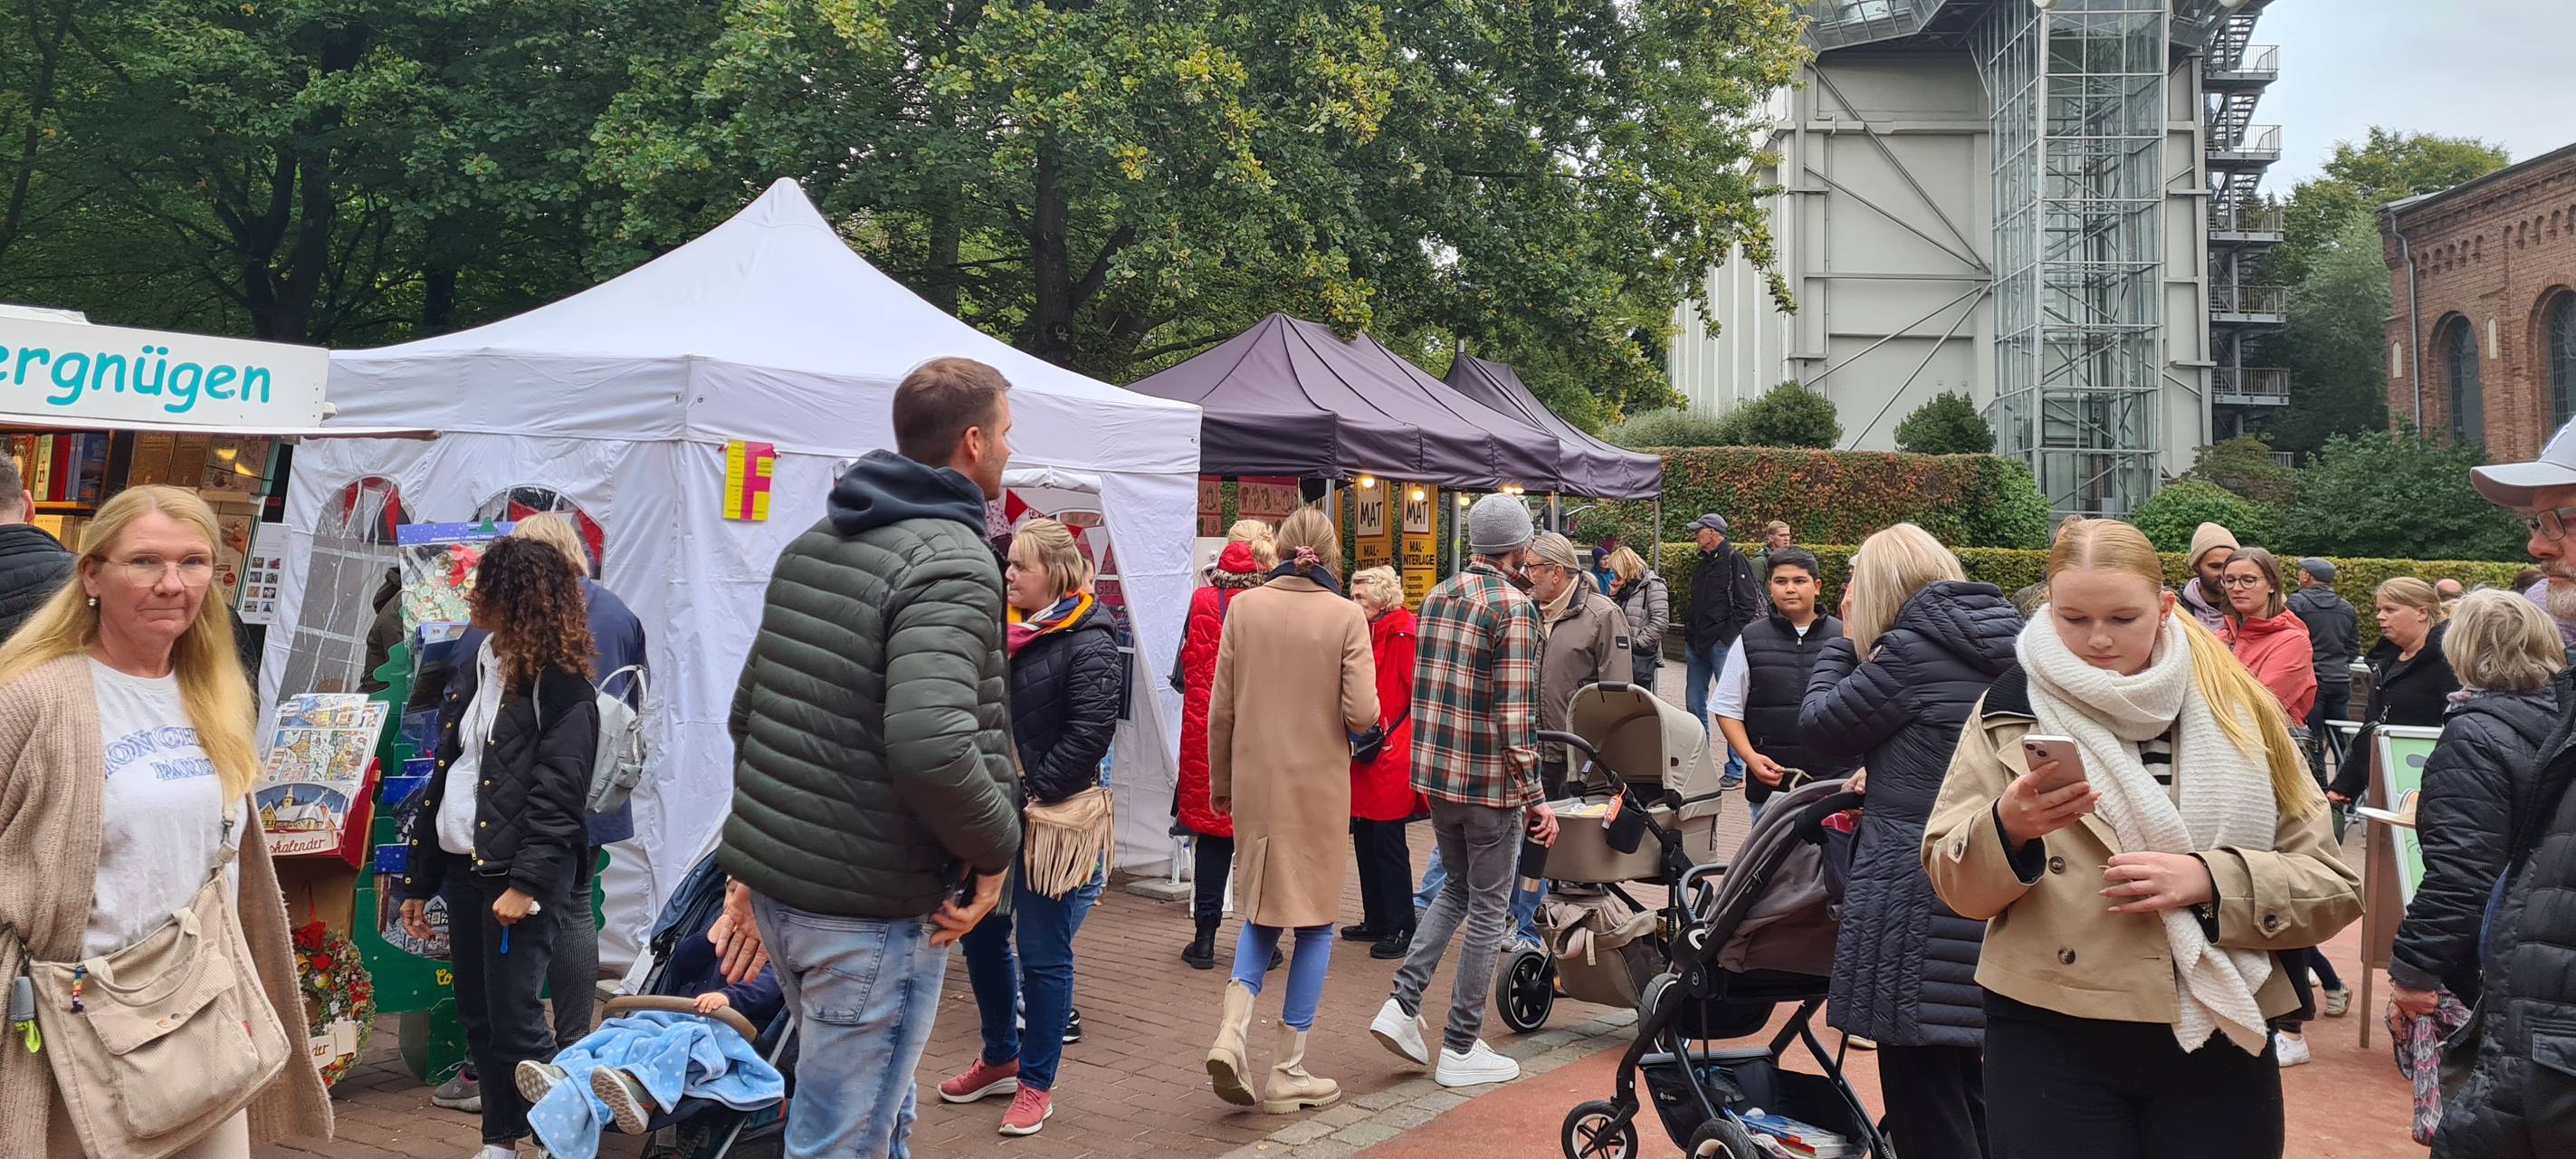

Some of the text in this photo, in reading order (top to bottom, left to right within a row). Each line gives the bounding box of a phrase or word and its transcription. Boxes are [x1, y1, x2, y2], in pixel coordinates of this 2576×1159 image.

[1360, 501, 1383, 528] MAT
[1406, 501, 1428, 525] MAT
[1403, 554, 1435, 566] NTERLAGE
[151, 727, 204, 750] CH
